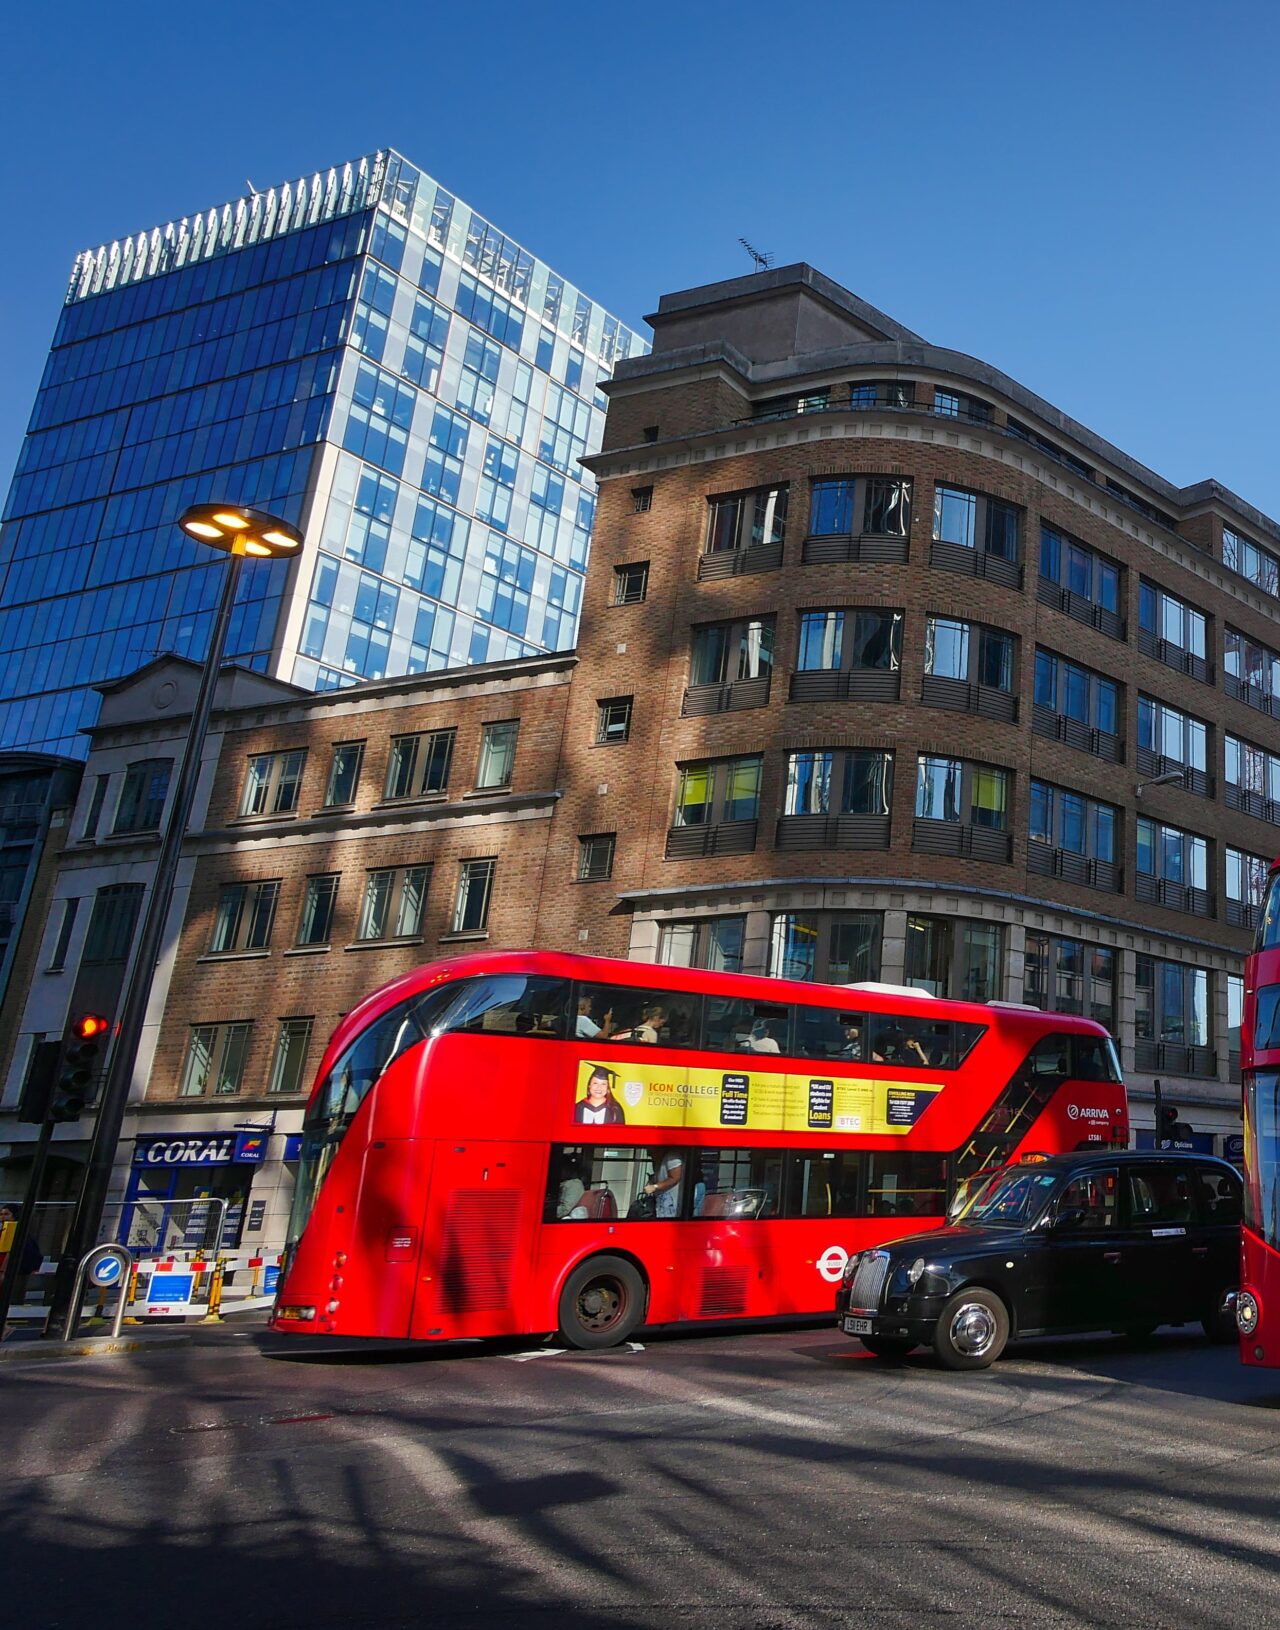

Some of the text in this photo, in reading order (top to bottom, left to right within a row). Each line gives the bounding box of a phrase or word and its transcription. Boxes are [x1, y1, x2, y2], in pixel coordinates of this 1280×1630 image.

[649, 1083, 719, 1095] ICON COLLEGE
[648, 1097, 693, 1108] LONDON
[809, 1110, 831, 1120] Loans
[1080, 1108, 1109, 1118] ARRIVA
[1174, 1141, 1193, 1149] Opticians
[147, 1139, 232, 1163] CORAL
